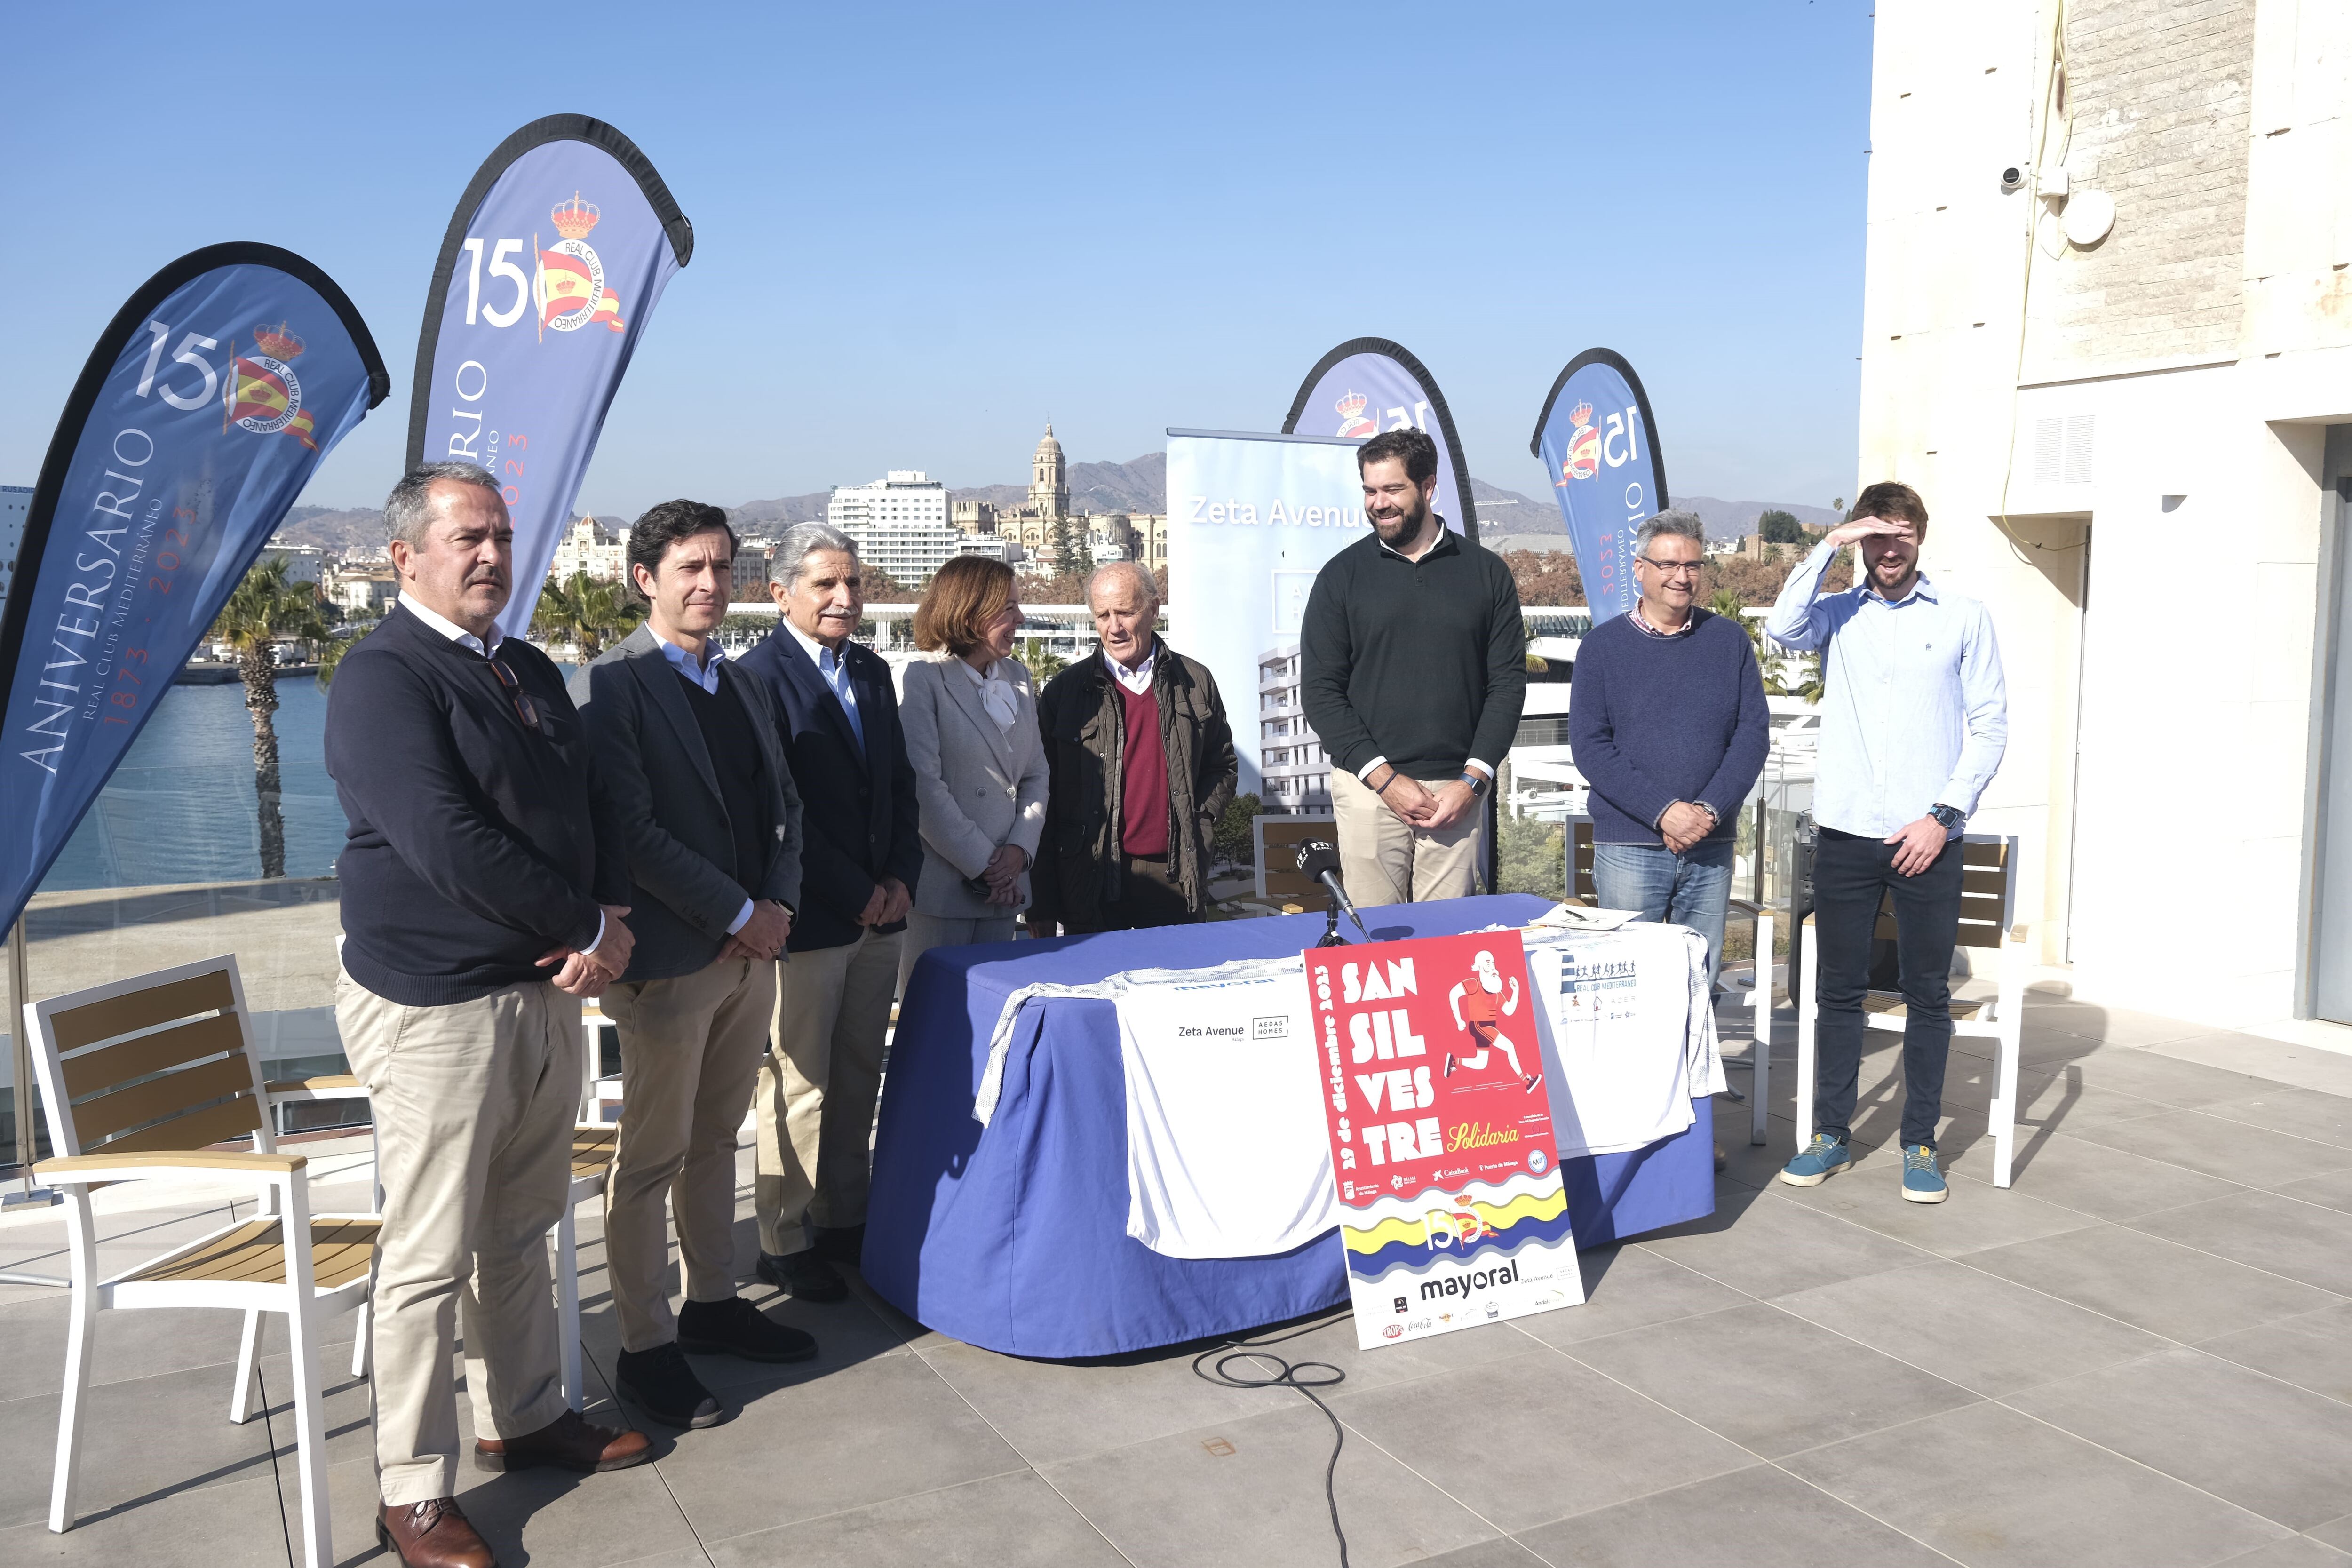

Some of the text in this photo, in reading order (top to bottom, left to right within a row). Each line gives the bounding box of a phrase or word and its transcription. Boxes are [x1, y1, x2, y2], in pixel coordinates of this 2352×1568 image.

[554, 242, 602, 330] REAL CLUB MEDITERRANEO
[243, 359, 299, 432] REAL CLUB MEDITERRANEO
[501, 434, 528, 529] 023
[1187, 495, 1259, 526] Zeta
[19, 428, 153, 777] ANIVERSARIO
[83, 498, 162, 720] REAL CLUB MEDITERRÁNEO
[104, 506, 197, 725] 1873 2023
[1173, 978, 1276, 991] mayoral
[1341, 957, 1418, 1003] SAN
[1591, 983, 1600, 991] CUB
[1178, 1026, 1244, 1036] Zeta Avenue
[1349, 1008, 1427, 1064] SIL
[1324, 1015, 1348, 1113] diciembre
[1353, 1065, 1435, 1115] VES
[1337, 1116, 1352, 1143] de
[1361, 1116, 1444, 1166] TRE
[1446, 1122, 1519, 1152] Solidaria
[1444, 1166, 1470, 1177] CaixaBank
[1420, 1259, 1519, 1301] mayoral
[1383, 1325, 1404, 1337] TROPS
